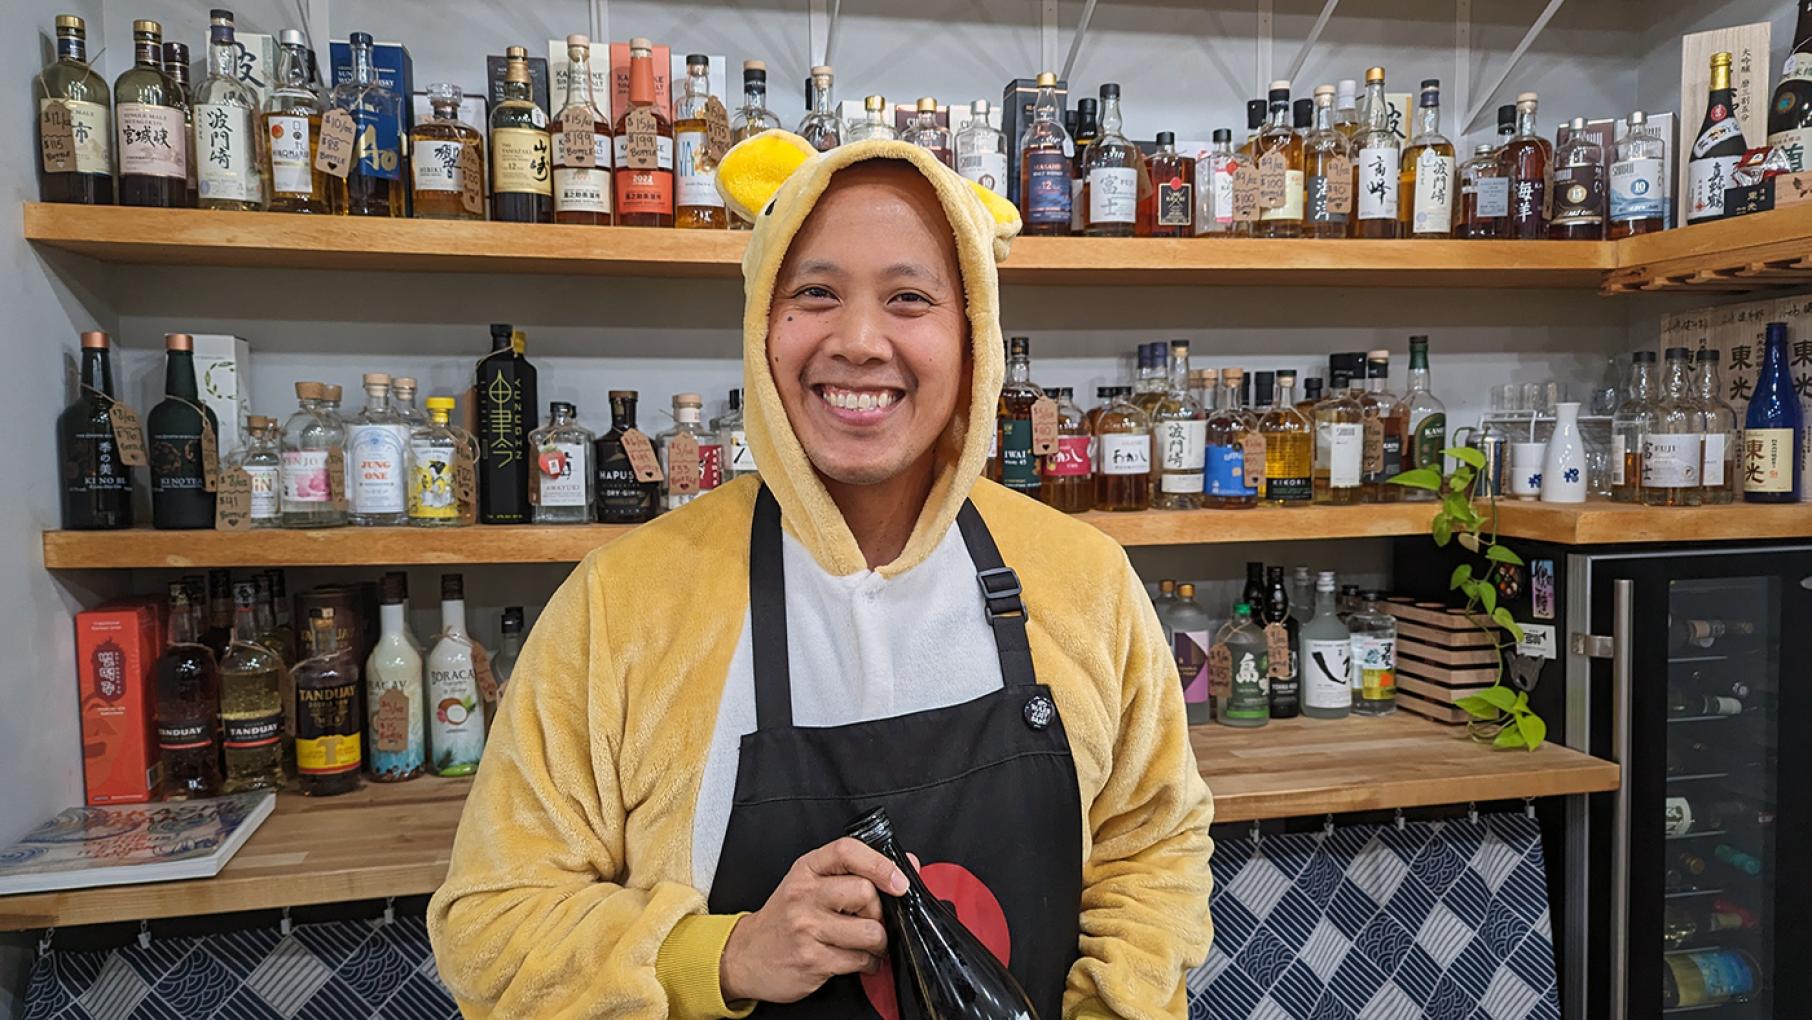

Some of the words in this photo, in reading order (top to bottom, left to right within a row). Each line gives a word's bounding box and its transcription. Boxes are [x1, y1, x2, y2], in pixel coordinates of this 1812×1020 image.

[565, 133, 591, 147] $199
[629, 132, 654, 148] $199
[1635, 182, 1645, 192] 10
[1654, 444, 1676, 453] FUJI
[1004, 450, 1026, 459] IWAI
[361, 460, 391, 469] JUNG
[1745, 439, 1765, 484] 東光
[364, 470, 387, 480] ONE
[99, 477, 114, 485] NO
[299, 684, 356, 702] TANDUAY
[230, 722, 279, 736] TANDUAY
